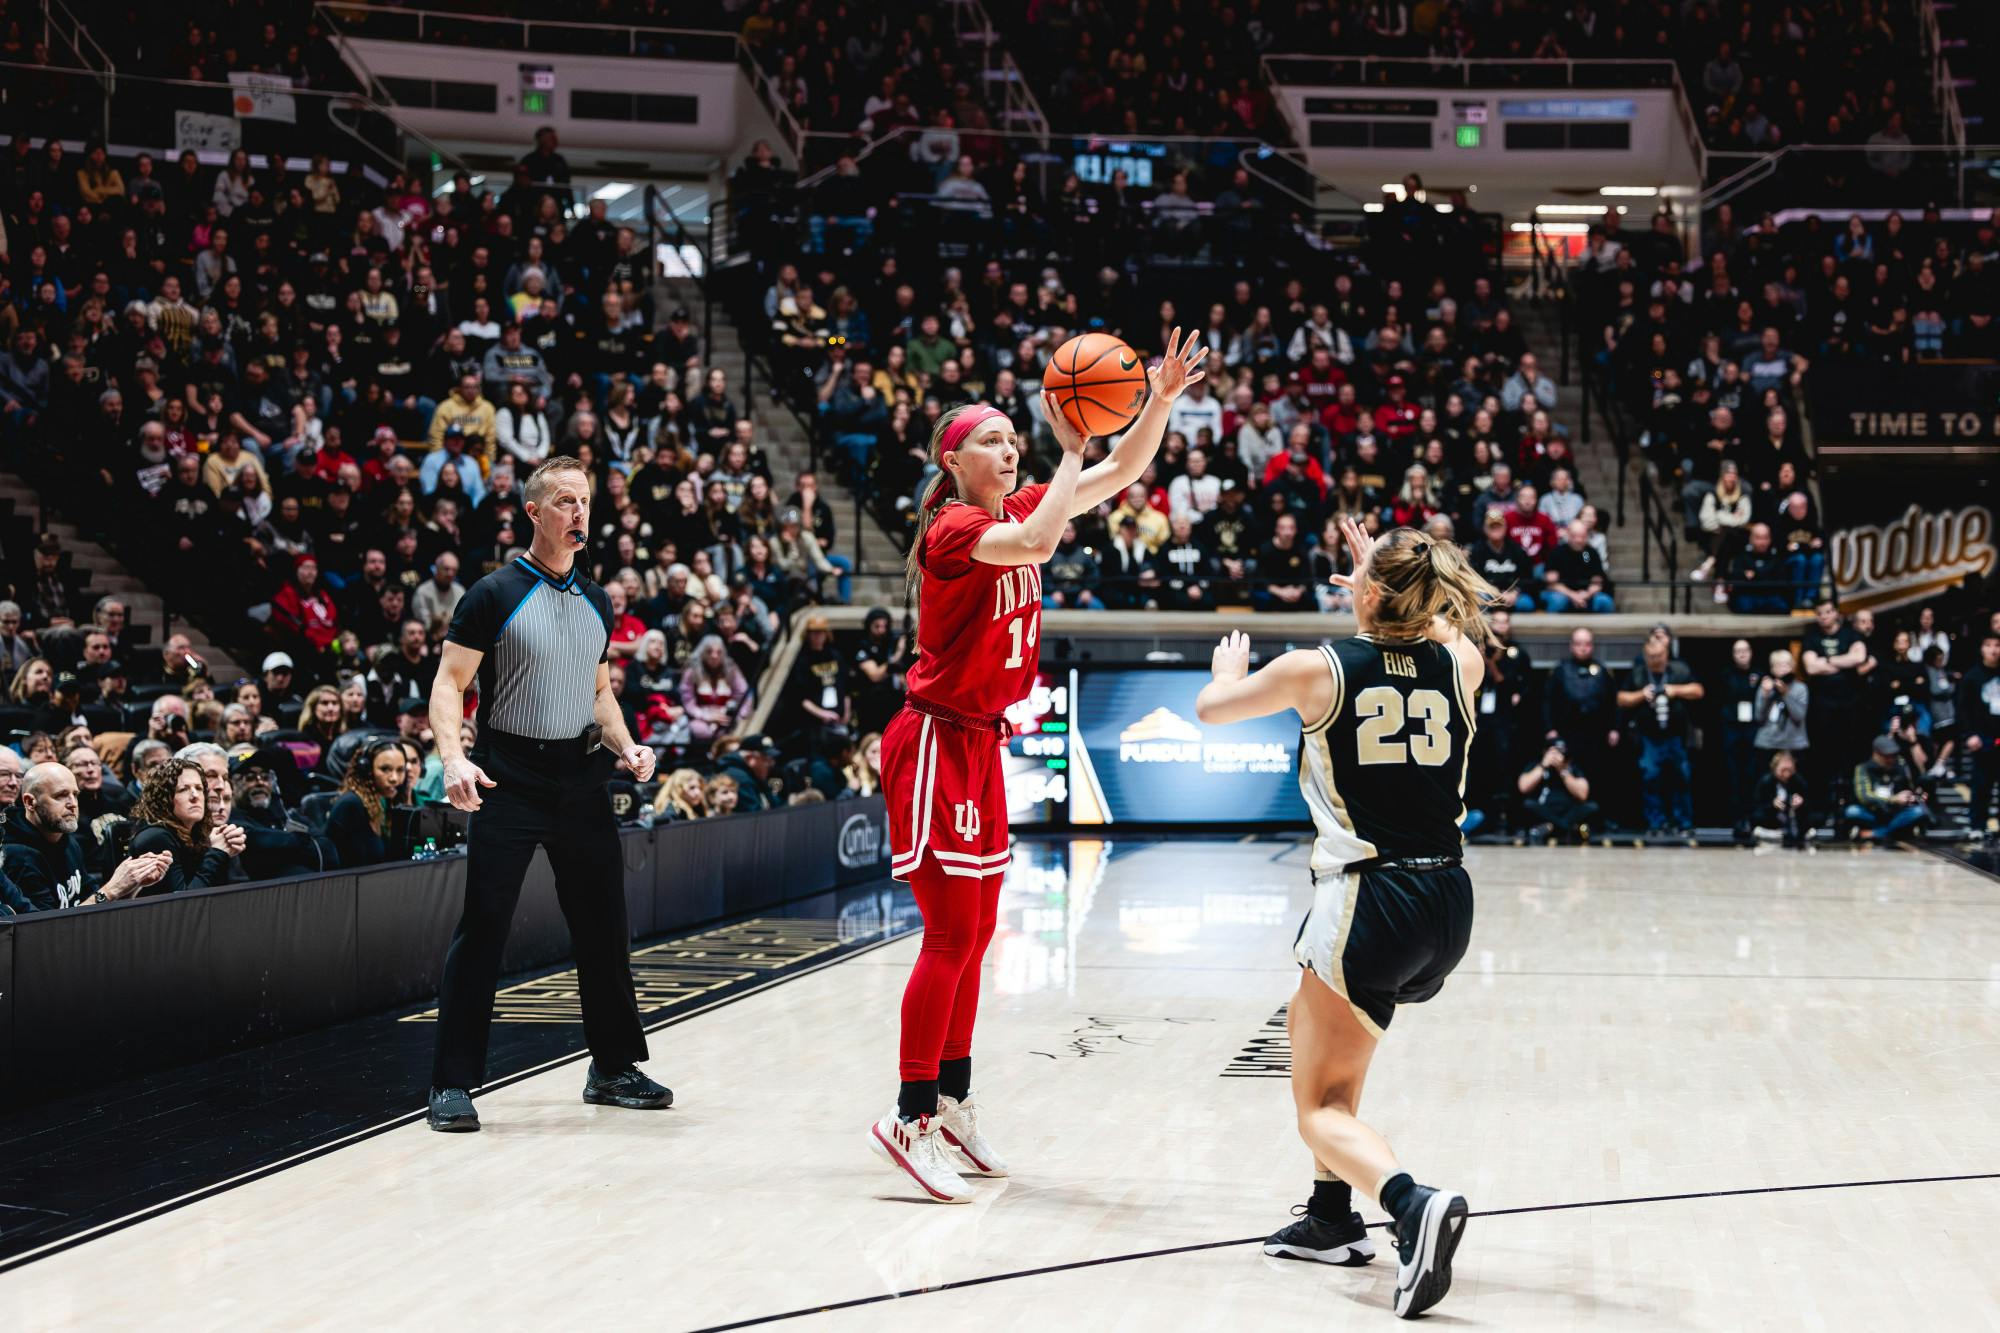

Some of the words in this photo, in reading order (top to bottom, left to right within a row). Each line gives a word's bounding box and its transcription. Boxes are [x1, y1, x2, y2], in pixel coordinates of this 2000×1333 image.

[1850, 412, 1928, 436] TIME
[1941, 412, 1981, 436] TO
[1831, 503, 1998, 592] urdue
[1383, 651, 1418, 679] ELLIS
[1355, 686, 1452, 767] 23
